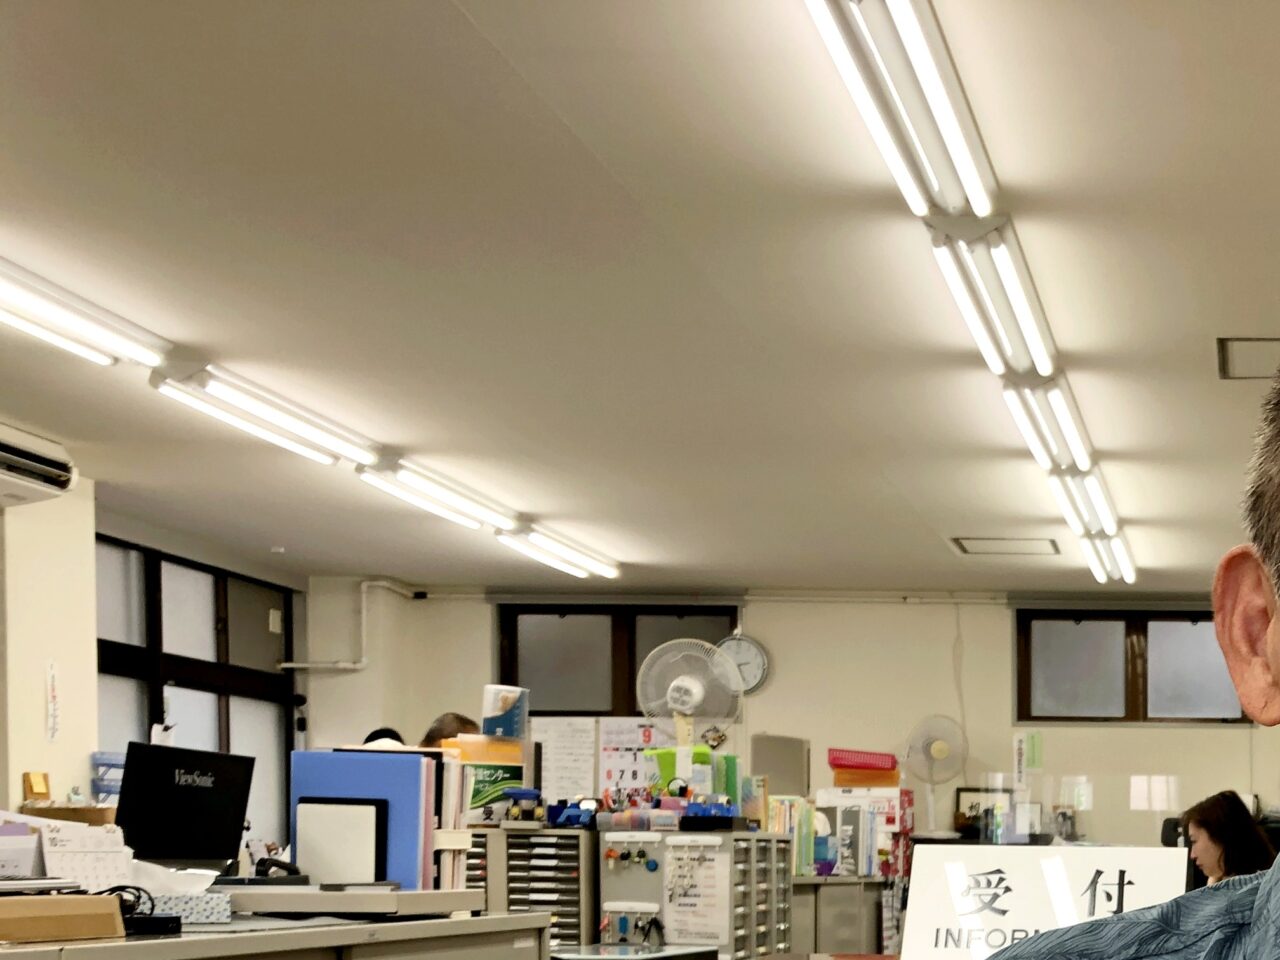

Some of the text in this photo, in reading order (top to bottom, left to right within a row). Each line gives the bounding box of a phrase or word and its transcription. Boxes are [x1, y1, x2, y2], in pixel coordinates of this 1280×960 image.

[642, 727, 652, 745] 9
[632, 751, 638, 762] 1
[174, 768, 216, 788] ViewSonic
[619, 769, 626, 780] 7
[631, 769, 639, 781] 8
[934, 928, 1040, 948] INFOR
